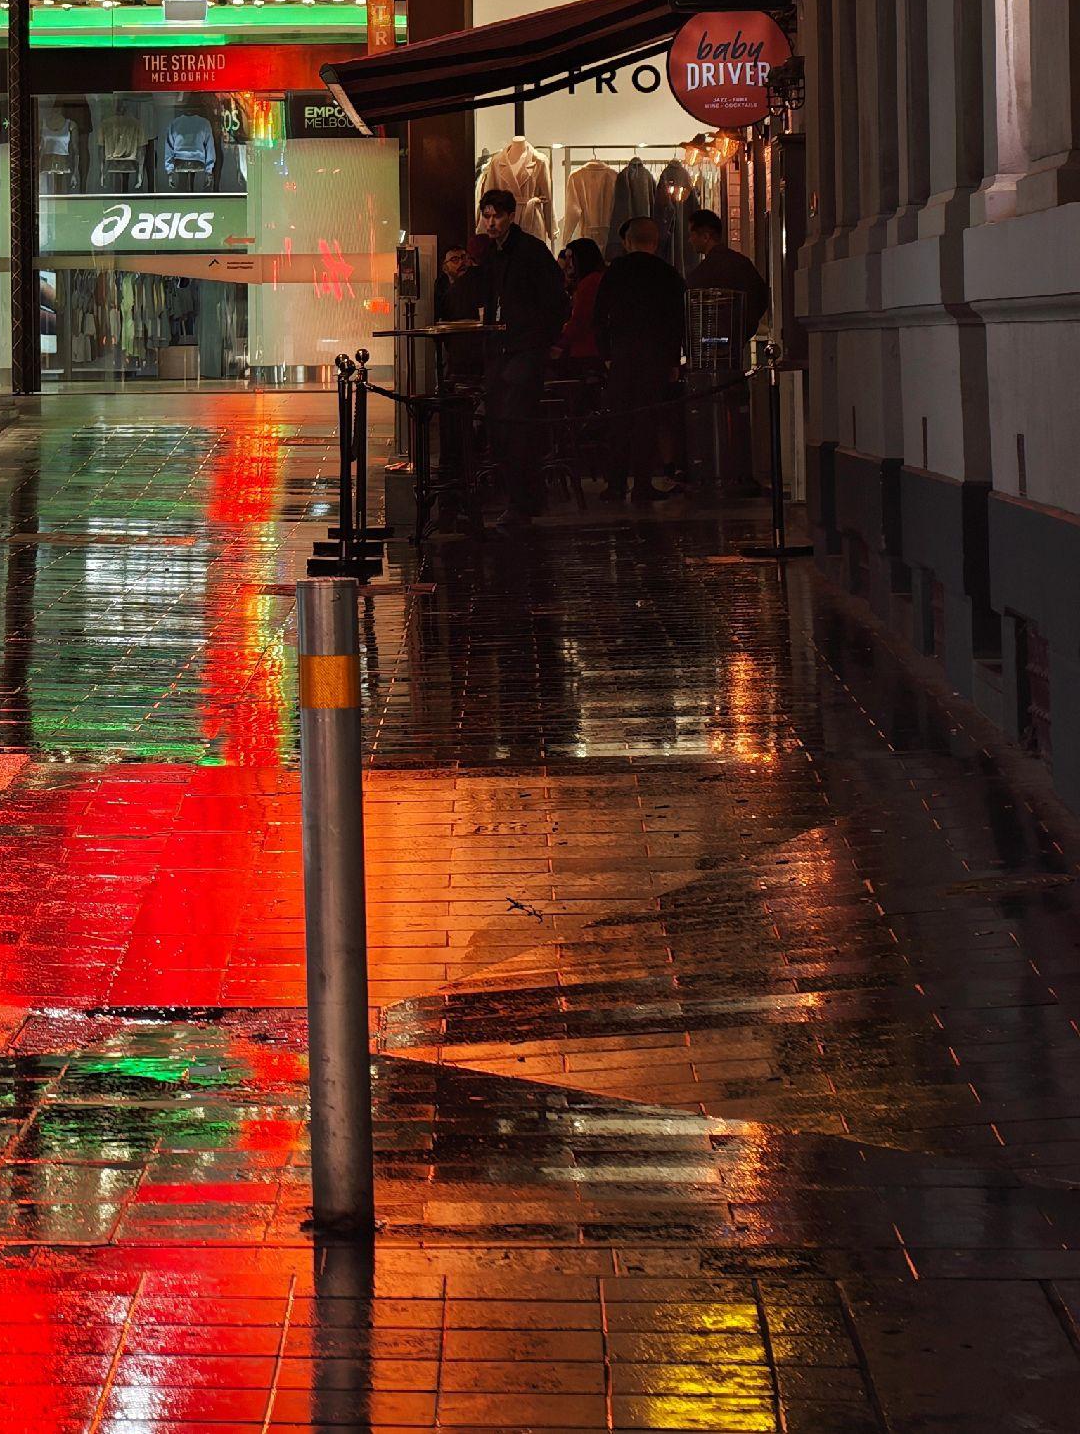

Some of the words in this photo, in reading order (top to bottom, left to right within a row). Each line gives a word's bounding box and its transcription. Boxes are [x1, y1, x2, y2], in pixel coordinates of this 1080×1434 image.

[696, 31, 764, 68] baby
[142, 55, 168, 71] THE
[171, 53, 226, 71] STRAND
[151, 71, 216, 83] MELBOURNE
[686, 62, 771, 92] DRIVER
[304, 106, 345, 118] EMPO
[304, 117, 354, 129] MELBOU
